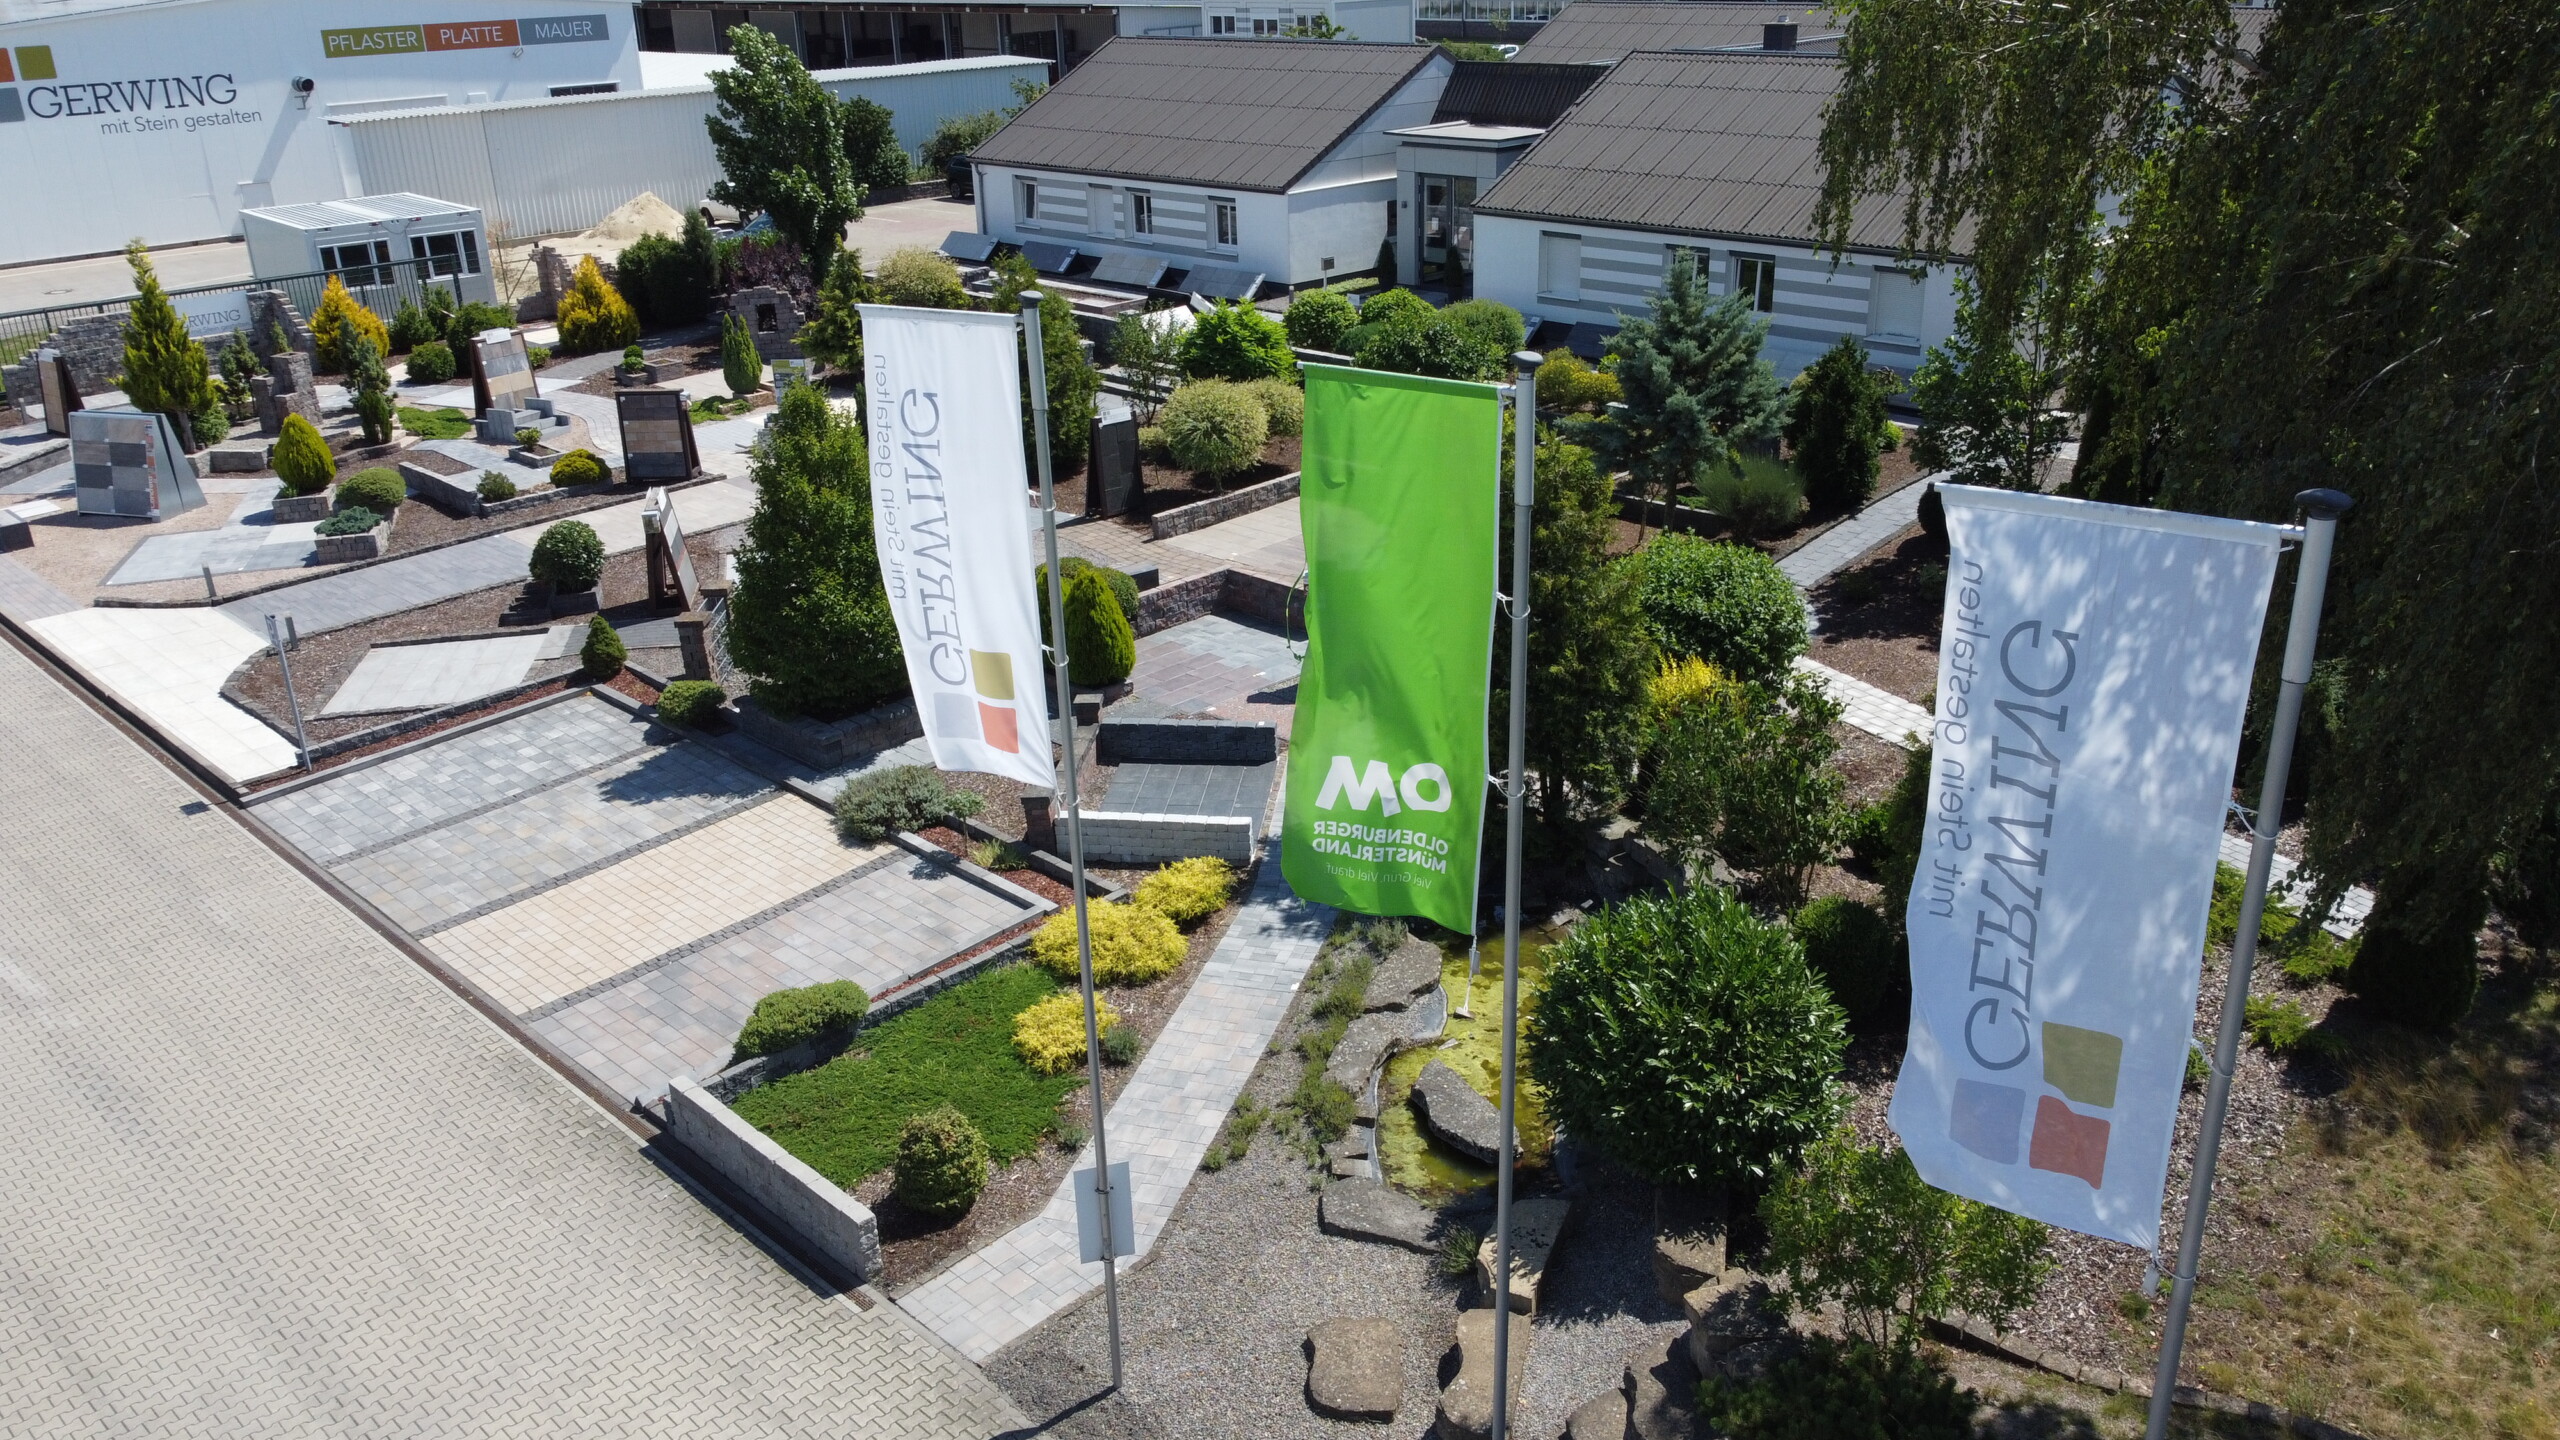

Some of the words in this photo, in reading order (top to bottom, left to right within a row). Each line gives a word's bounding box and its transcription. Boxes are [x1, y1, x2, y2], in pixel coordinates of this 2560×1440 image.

[327, 31, 418, 51] PFLASTER
[440, 26, 504, 44] PLATTE
[535, 21, 593, 39] MAUER
[27, 73, 238, 119] GERWING
[101, 118, 131, 135] mit
[134, 115, 179, 132] Stein
[184, 108, 262, 132] gestalten
[183, 309, 241, 328] RWING
